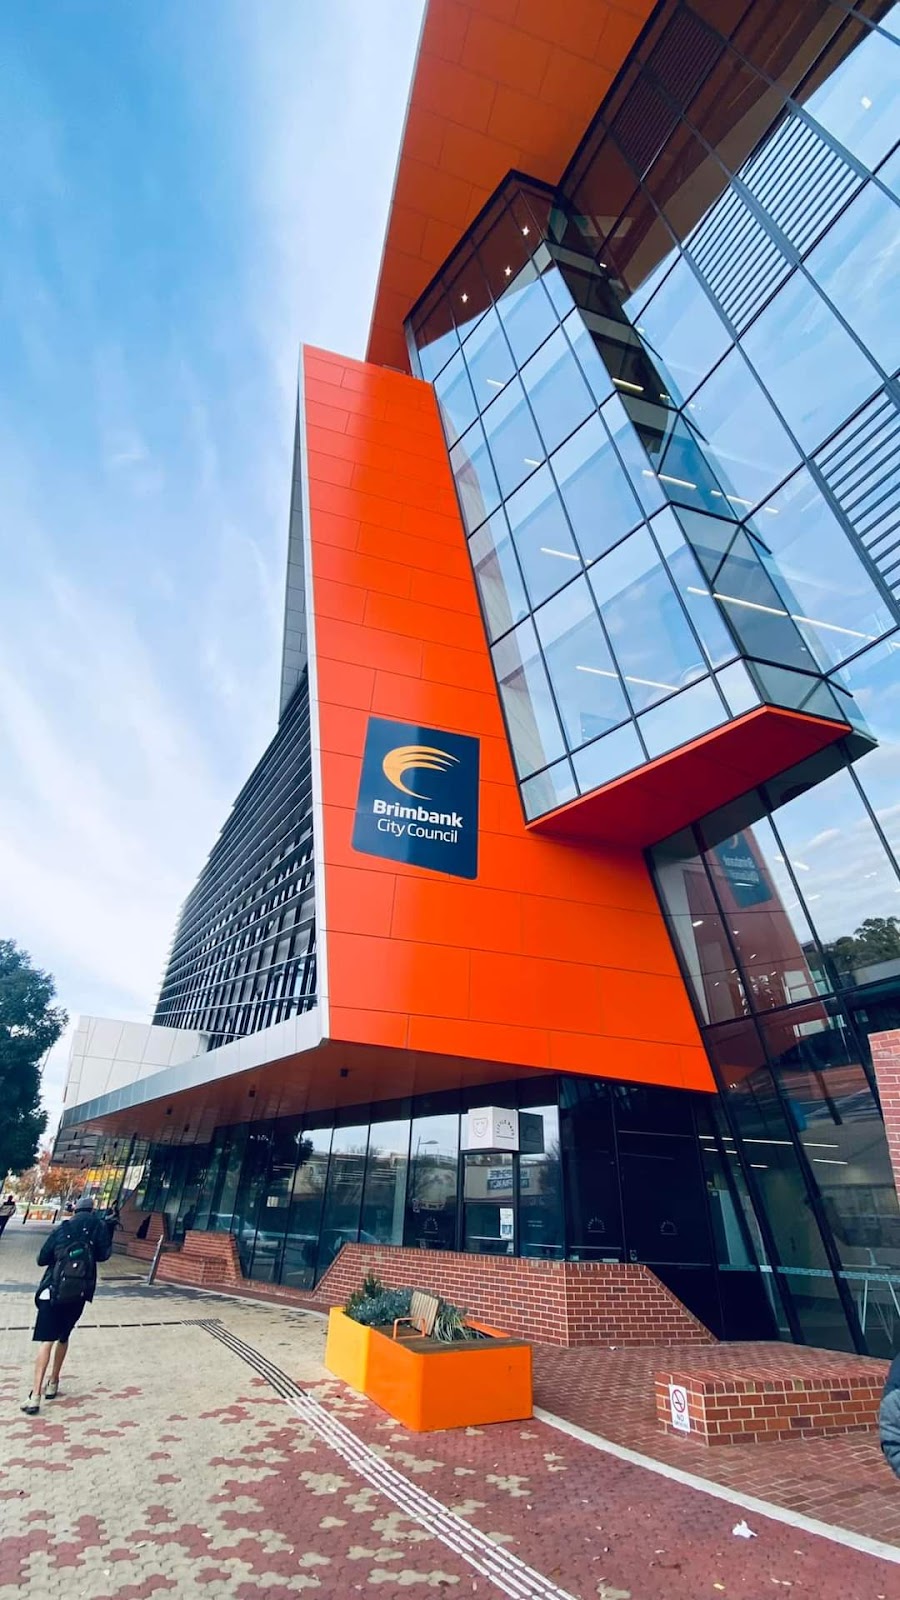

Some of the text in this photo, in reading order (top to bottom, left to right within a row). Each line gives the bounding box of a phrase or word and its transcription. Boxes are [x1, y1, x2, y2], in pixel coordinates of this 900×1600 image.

[373, 799, 463, 828] Brimbank
[377, 818, 458, 843] City Council
